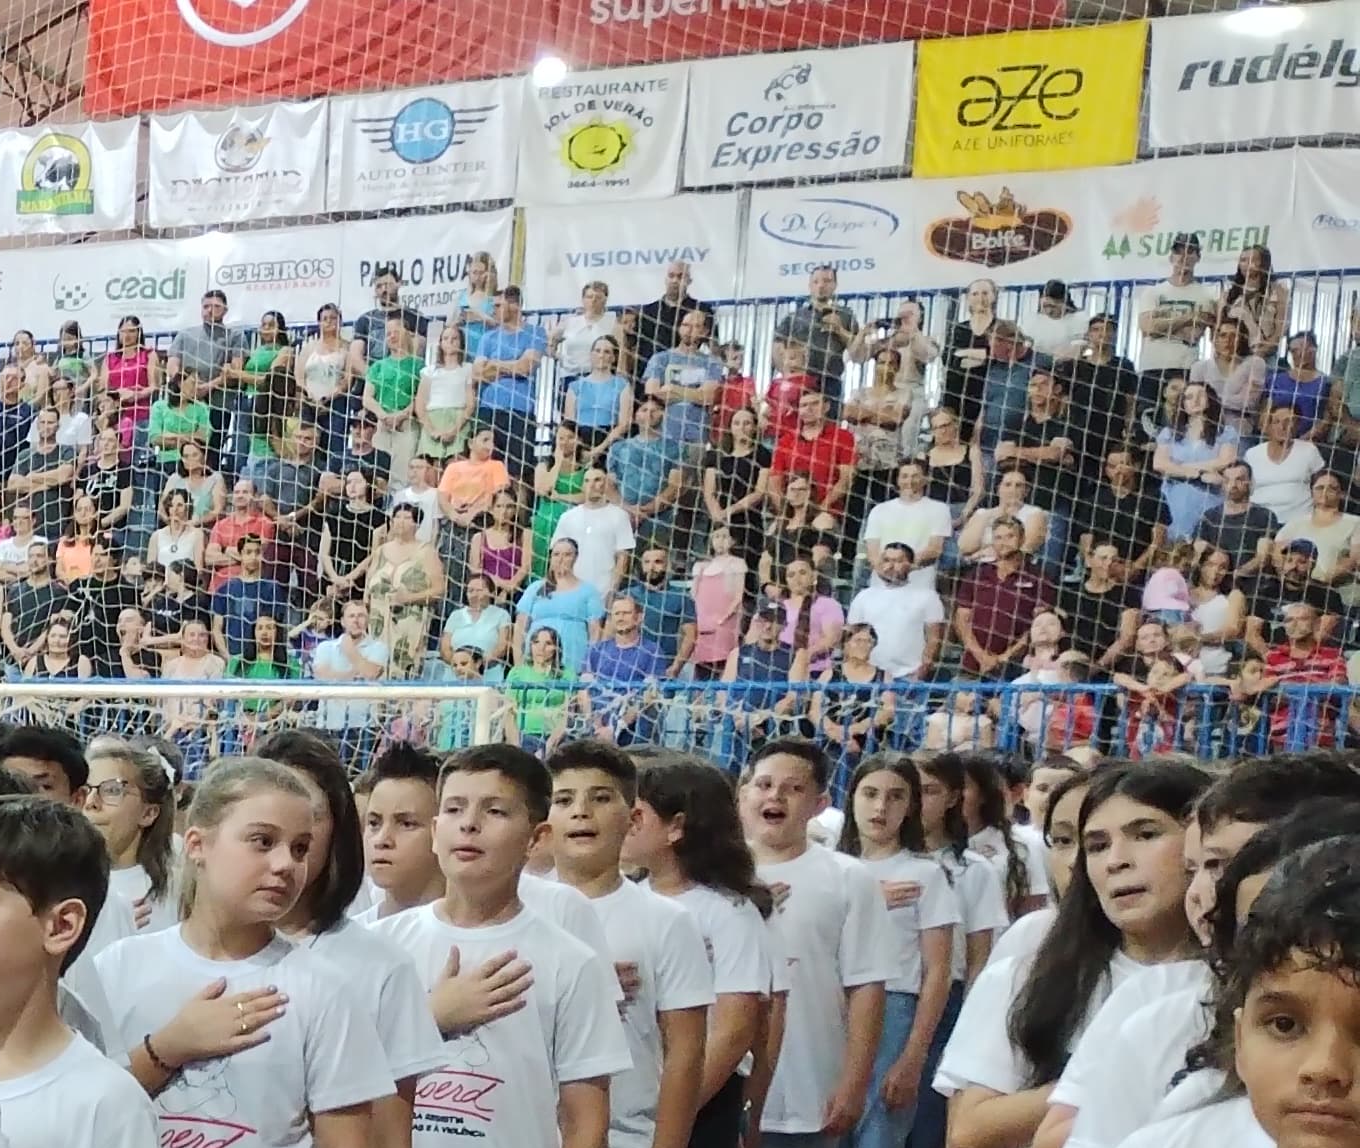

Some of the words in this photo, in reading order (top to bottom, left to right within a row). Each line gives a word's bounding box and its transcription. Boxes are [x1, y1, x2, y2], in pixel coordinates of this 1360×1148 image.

[395, 119, 449, 143] HG
[726, 111, 824, 138] Corpo
[711, 130, 882, 170] Expressão
[357, 168, 406, 182] AUTO
[411, 161, 487, 177] CENTER
[566, 246, 710, 269] VISIONWAY
[105, 267, 186, 300] ceadi
[215, 258, 335, 287] CELEIRO'S
